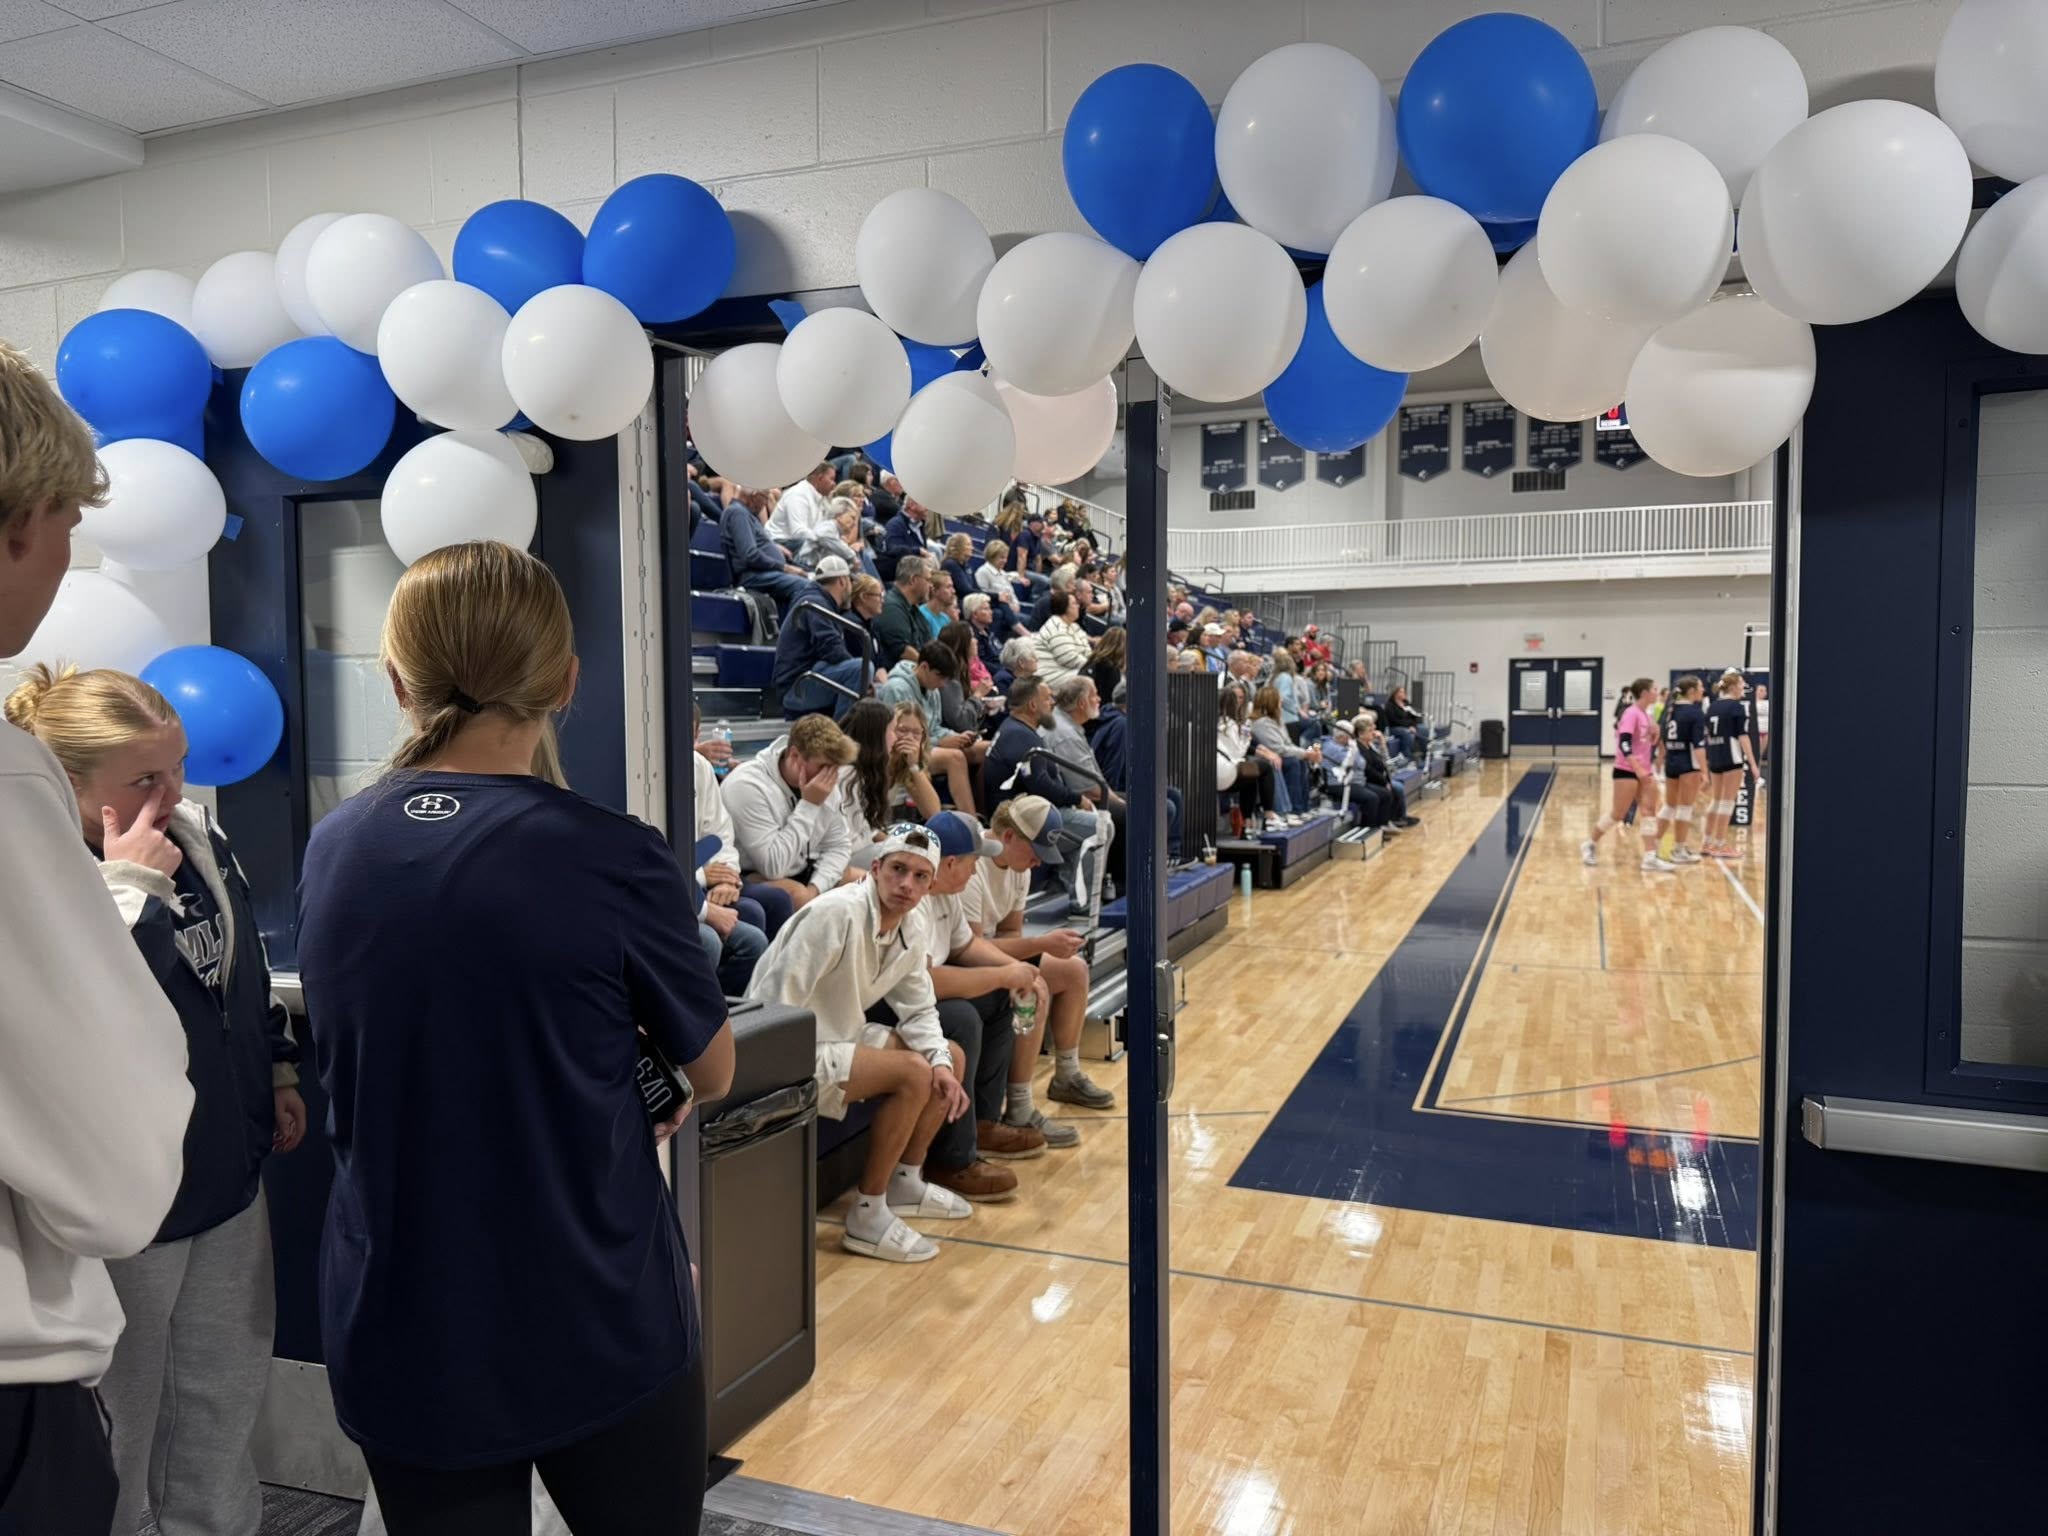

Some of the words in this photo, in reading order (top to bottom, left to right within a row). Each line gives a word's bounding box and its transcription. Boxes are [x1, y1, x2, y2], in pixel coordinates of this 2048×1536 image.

[1667, 719, 1678, 740] 2
[1710, 715, 1720, 735] 7
[636, 1056, 673, 1113] 6:40
